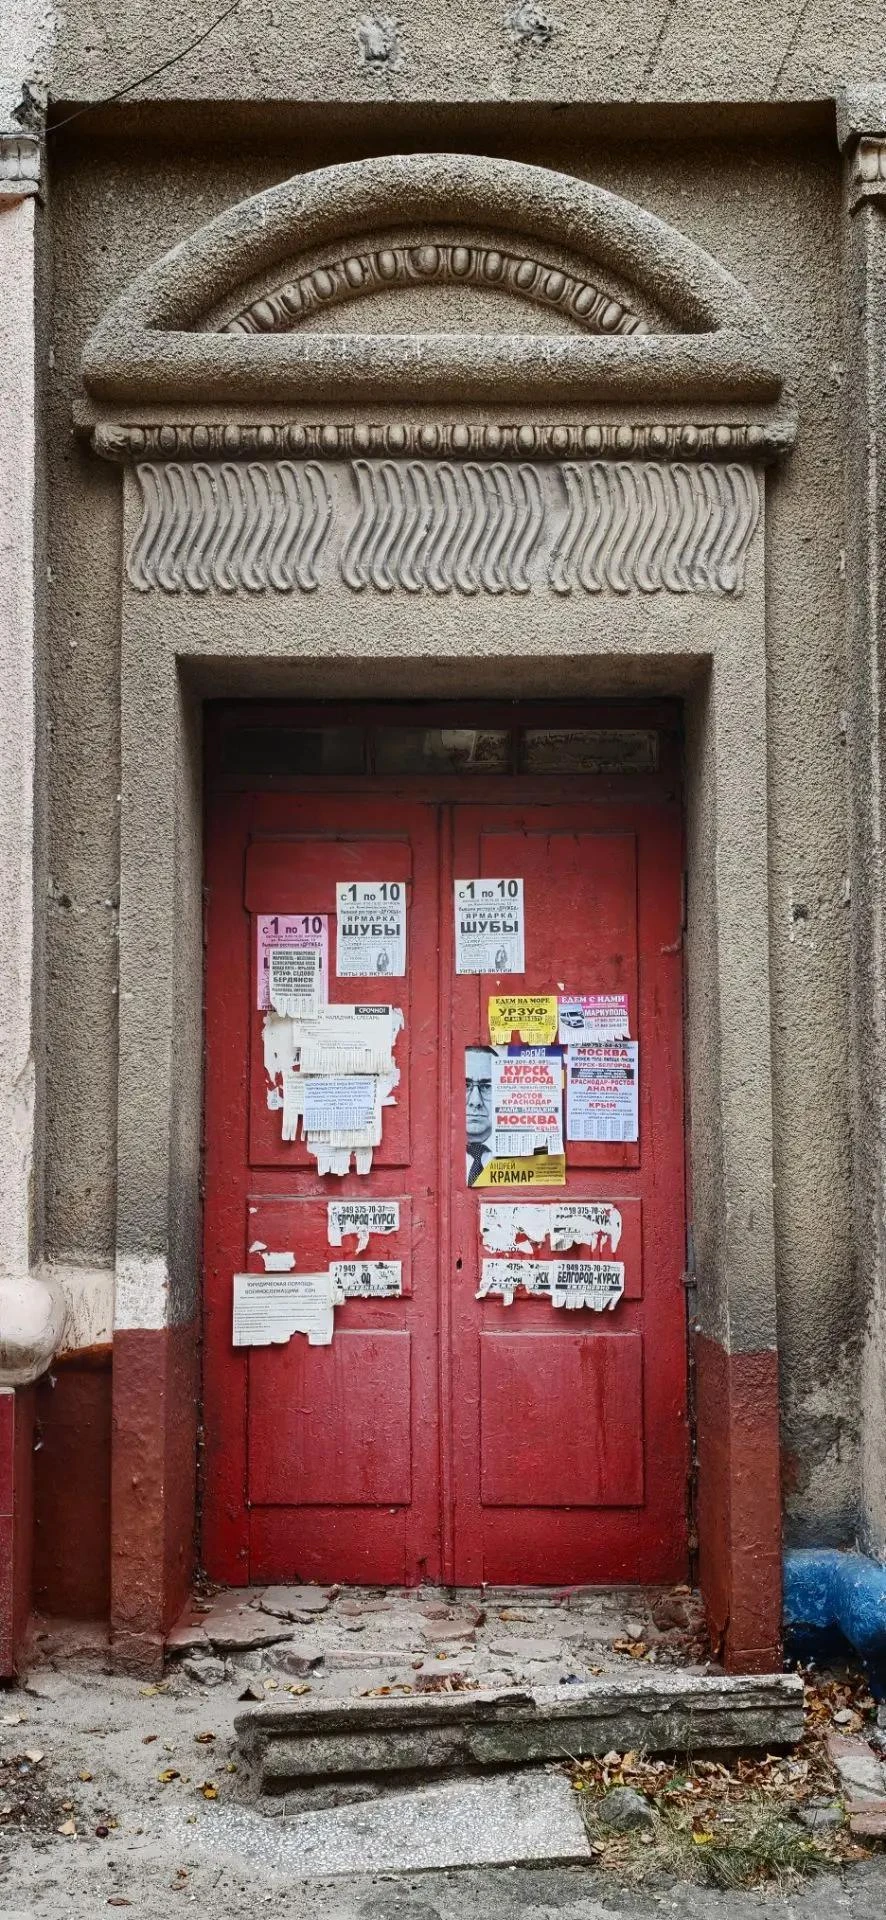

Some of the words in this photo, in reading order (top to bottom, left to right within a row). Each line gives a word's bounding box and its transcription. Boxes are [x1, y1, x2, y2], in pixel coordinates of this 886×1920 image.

[348, 884, 357, 902] 1
[380, 883, 400, 901] 10
[466, 881, 475, 899] 1
[482, 890, 494, 898] по
[497, 880, 518, 898] 10
[270, 917, 279, 934] 1
[302, 916, 322, 934] 10
[342, 924, 400, 936] ШУБЫ
[461, 921, 519, 933] ШУБЫ
[499, 1007, 548, 1016] УРЗУФ
[504, 1065, 549, 1075] КУРСК
[500, 1075, 554, 1084] БЕЛГОРОД
[497, 1115, 557, 1124] МОСКВА
[489, 1161, 516, 1170] АНДРЕЙ
[490, 1170, 534, 1183] КРАМАР
